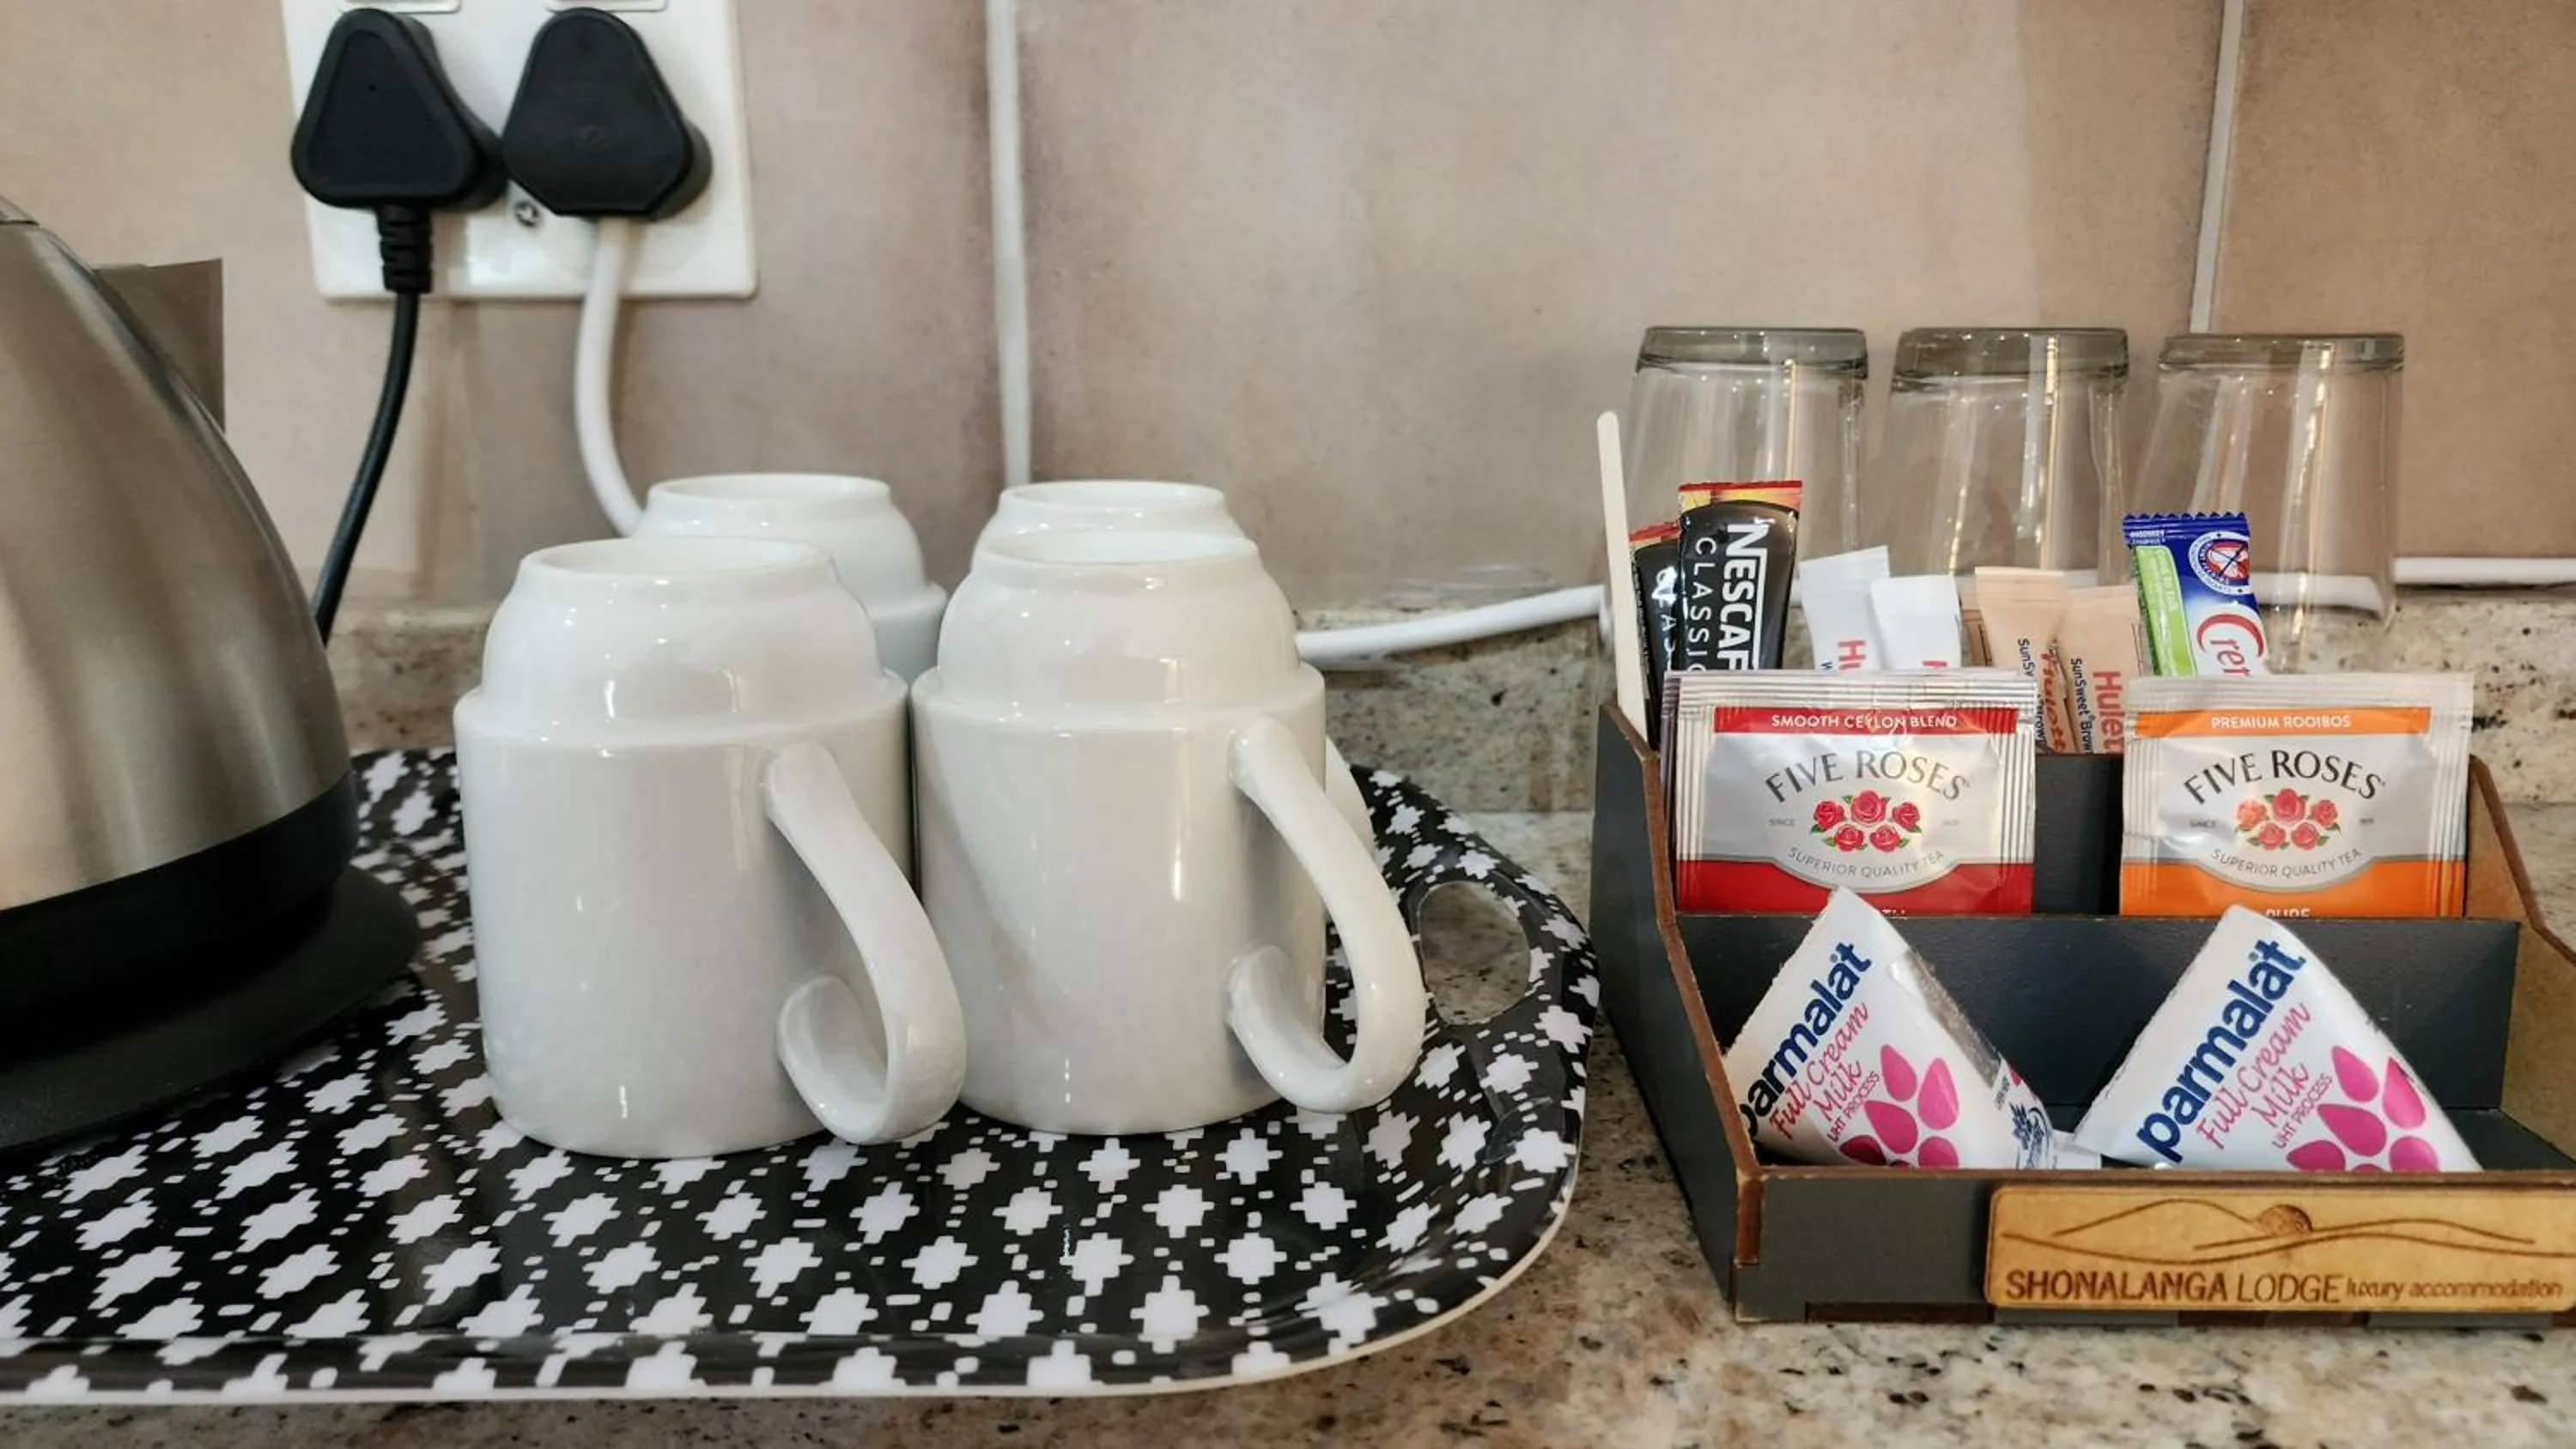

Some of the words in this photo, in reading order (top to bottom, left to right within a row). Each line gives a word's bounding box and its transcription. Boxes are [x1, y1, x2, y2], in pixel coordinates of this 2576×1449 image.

[1716, 524, 1770, 672] NESCAF
[1771, 714, 1838, 728] SMOOTH
[1844, 714, 1906, 729] CEYLON
[1910, 714, 1958, 728] BLEND
[2211, 716, 2280, 729] PREMIUM
[2283, 715, 2351, 729] ROOIBOS
[1765, 752, 1844, 803] FIVE
[1856, 749, 1967, 801] ROSES
[2184, 752, 2263, 805] FIVE
[2270, 749, 2382, 800] ROSES
[1788, 846, 1859, 877] SUPERIOR
[1860, 860, 1918, 878] QUALITY
[1923, 850, 1945, 866] TEA
[2211, 847, 2278, 877] SUPERIOR
[2281, 858, 2336, 879] QUALITY
[2338, 847, 2361, 866] TEA
[1769, 1080, 1814, 1141] Full
[1807, 1002, 1870, 1084] Cream
[2136, 937, 2306, 1164] parmalat
[2196, 1081, 2250, 1150] Full
[2236, 1003, 2315, 1093] Cream
[1812, 1058, 1862, 1124] Milk
[1826, 1116, 1848, 1142] UHT
[1843, 1070, 1881, 1119] PROCESS
[2251, 1061, 2310, 1131] Milk
[2271, 1122, 2296, 1150] UHT
[2293, 1071, 2333, 1125] PROCESS
[2005, 1269, 2228, 1301] SHONALANGA
[2236, 1272, 2345, 1305] LODGE
[2345, 1276, 2404, 1302] luxury
[2409, 1279, 2564, 1300] accommodation
